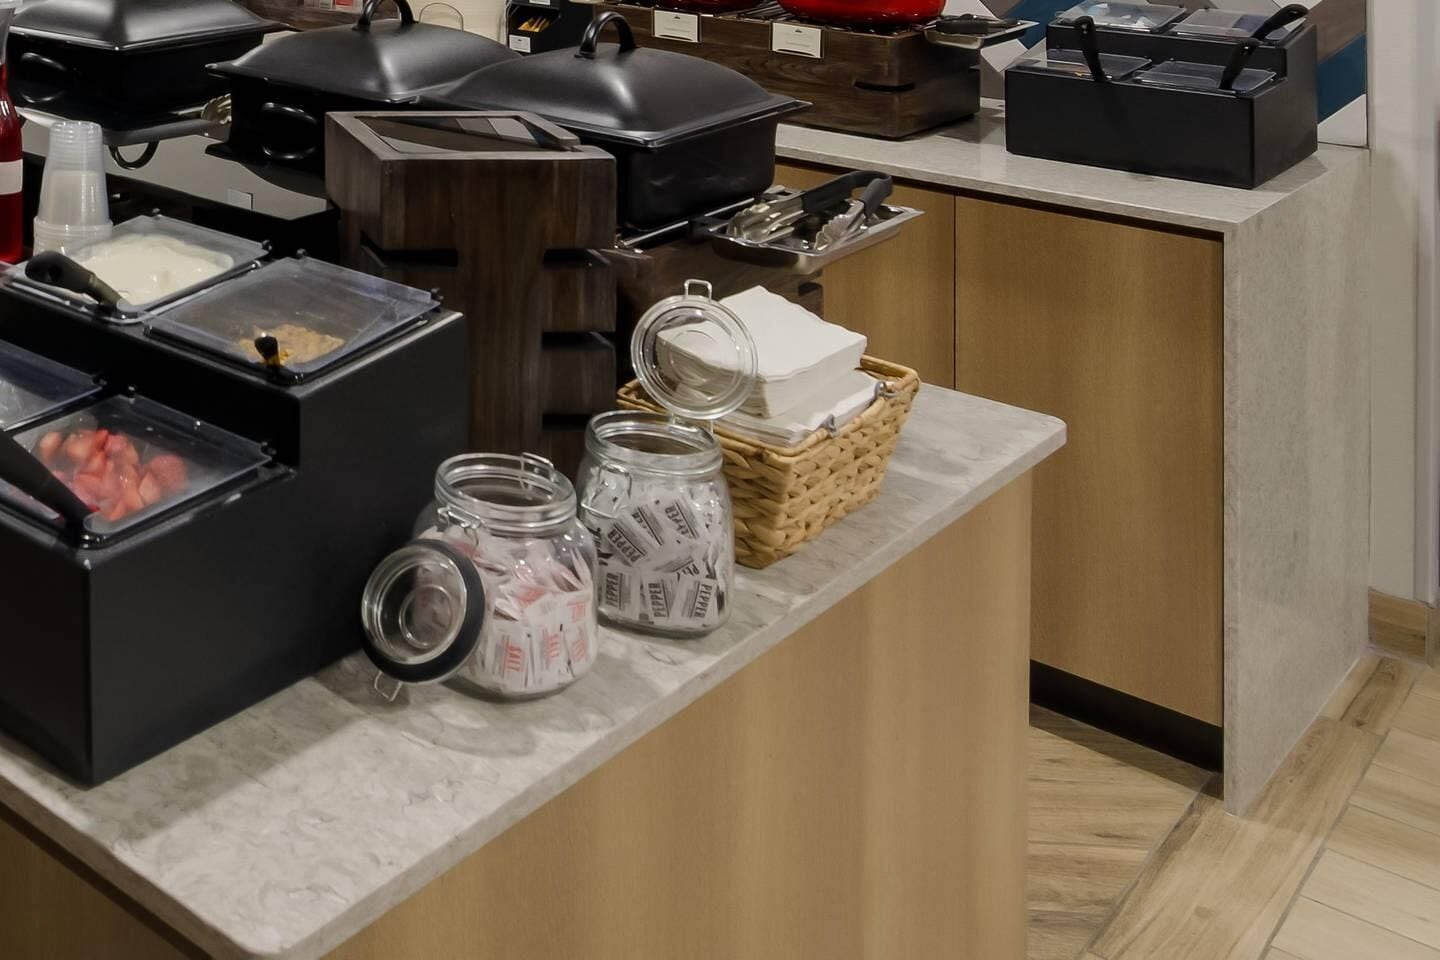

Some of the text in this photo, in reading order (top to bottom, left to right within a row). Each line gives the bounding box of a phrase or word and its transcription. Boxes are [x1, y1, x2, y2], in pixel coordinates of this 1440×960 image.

[607, 528, 642, 563] PEPPER
[605, 572, 619, 609] PEPPER
[648, 582, 667, 618] PEPPER
[694, 583, 713, 618] PEPPER
